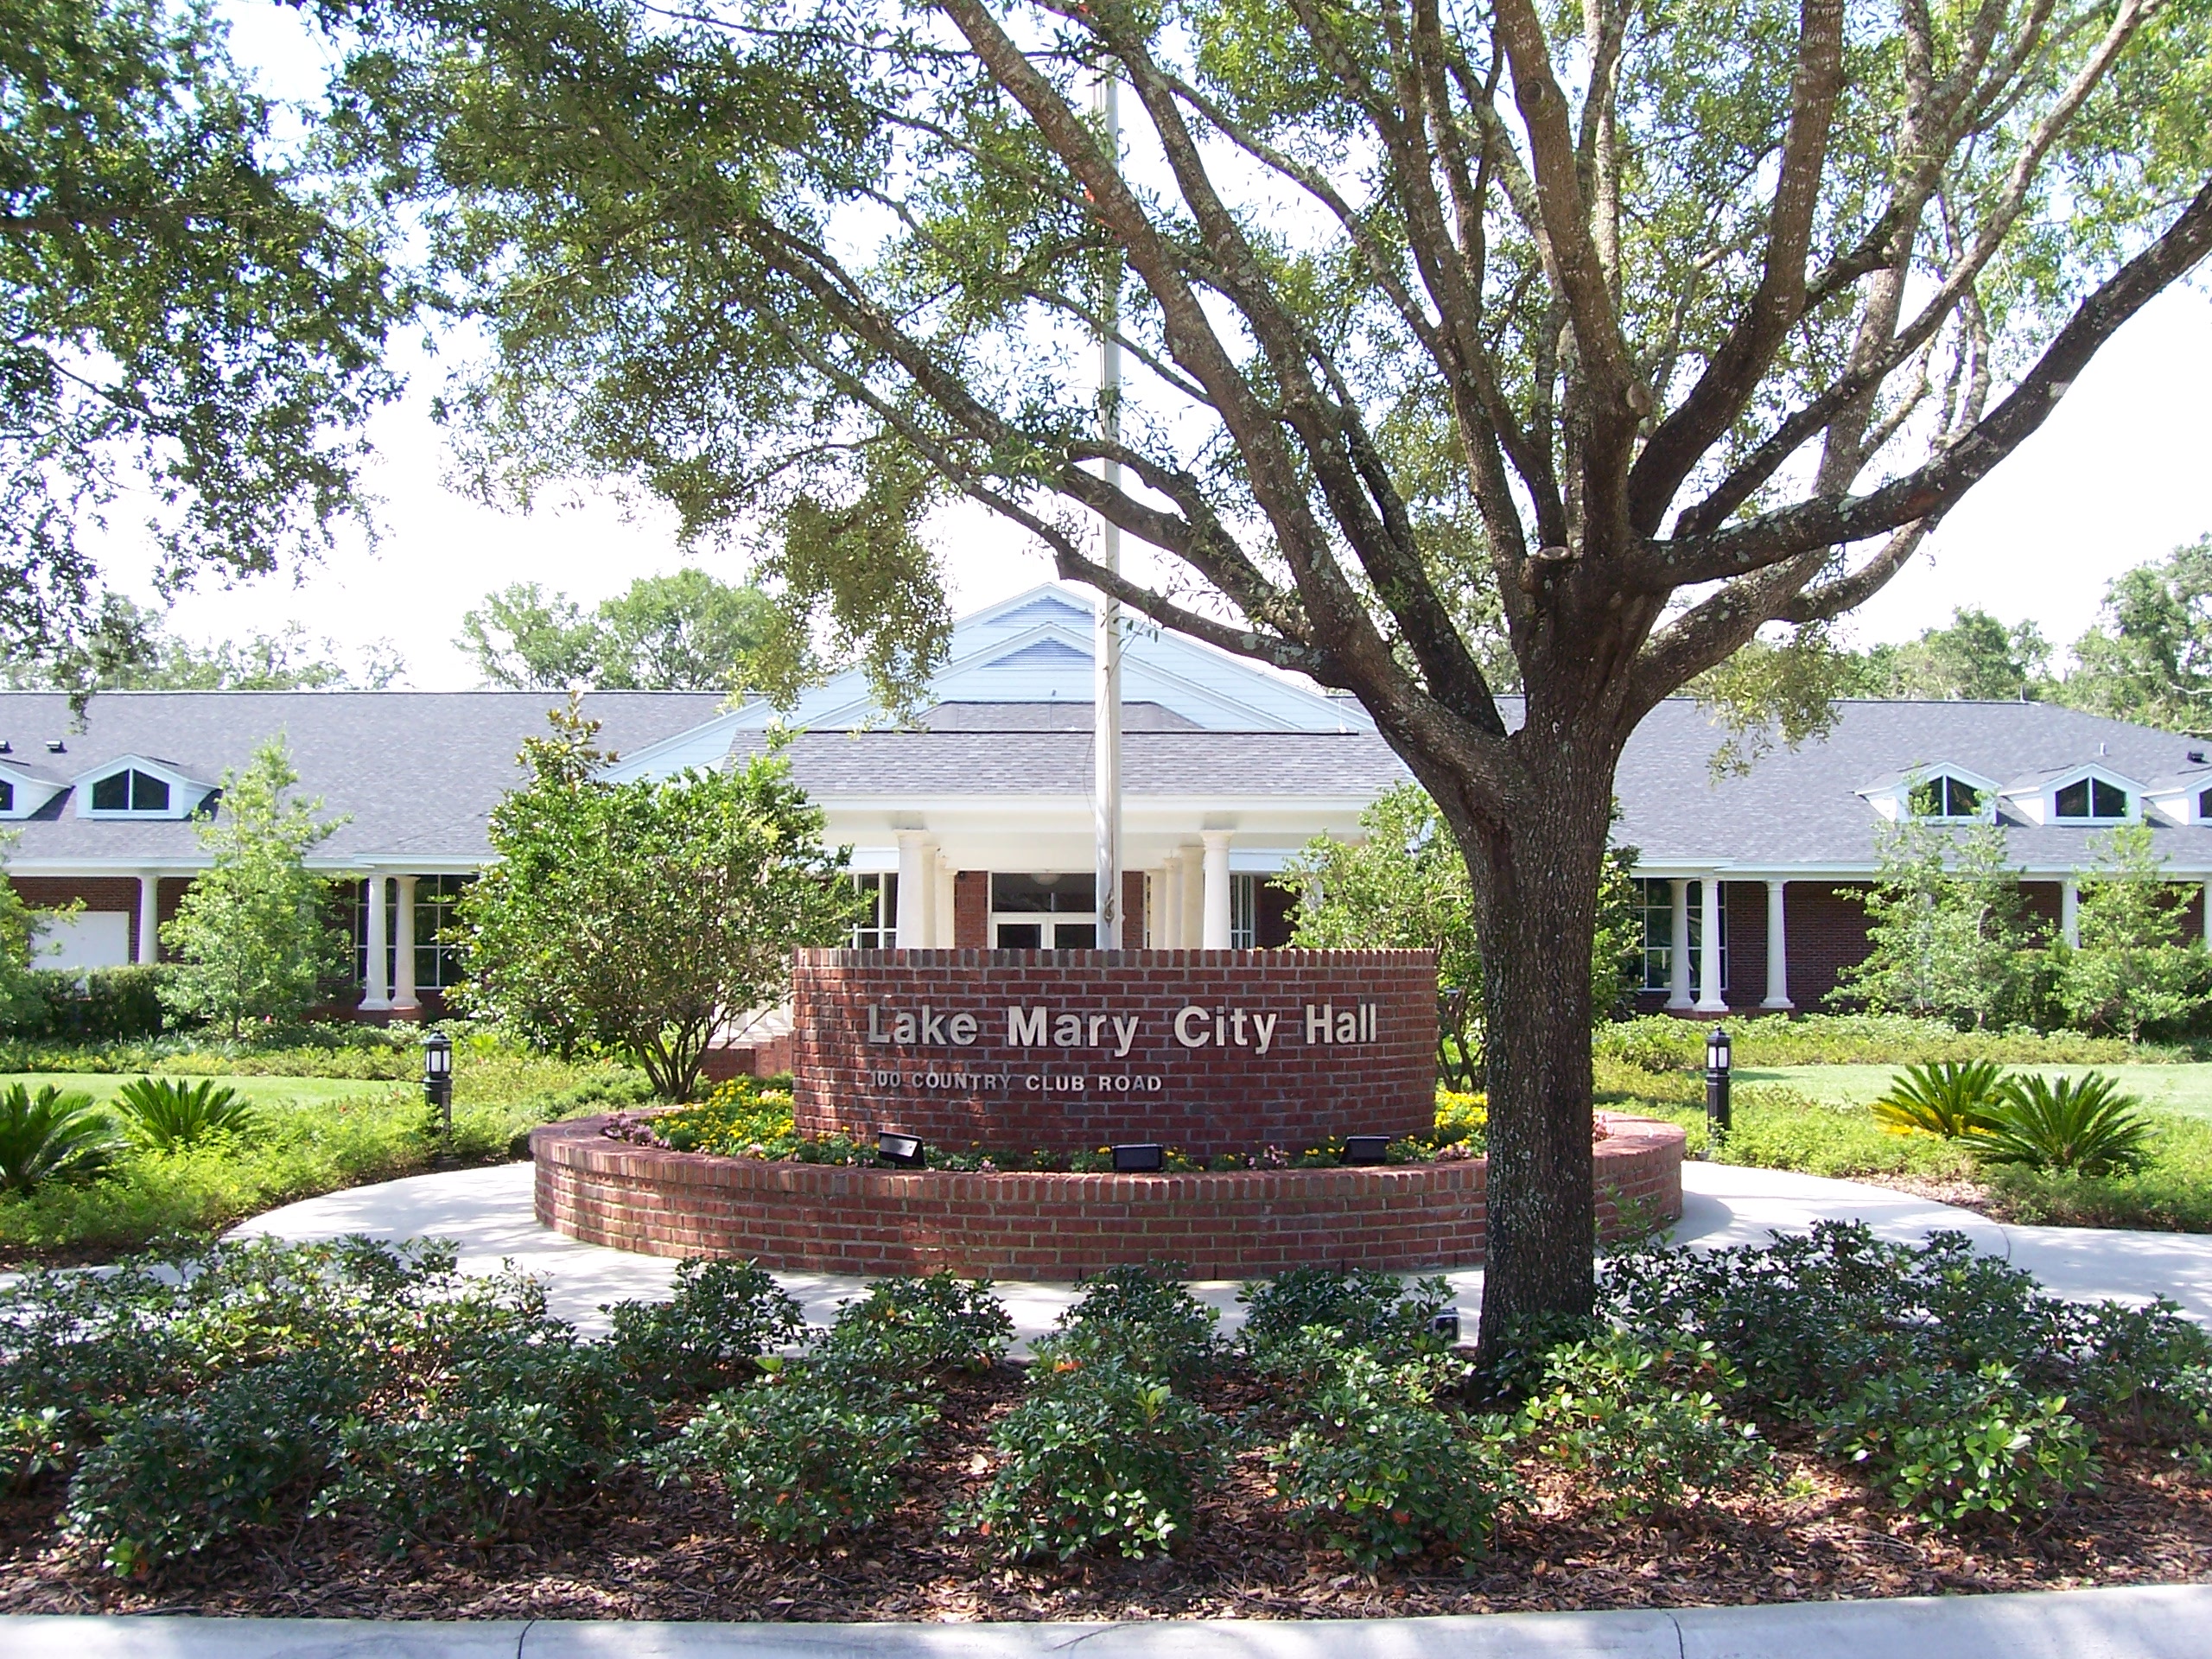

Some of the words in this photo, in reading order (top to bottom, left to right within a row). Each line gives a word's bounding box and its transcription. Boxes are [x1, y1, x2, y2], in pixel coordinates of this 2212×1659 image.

[867, 1004, 978, 1046] Lake
[1007, 1006, 1141, 1058] Mary
[1173, 1005, 1278, 1055] City
[1305, 1003, 1377, 1045] Hall
[871, 1072, 901, 1089] 100
[912, 1073, 1012, 1091] COUNTRY
[1025, 1075, 1085, 1092] CLUB
[1097, 1075, 1163, 1092] ROAD
